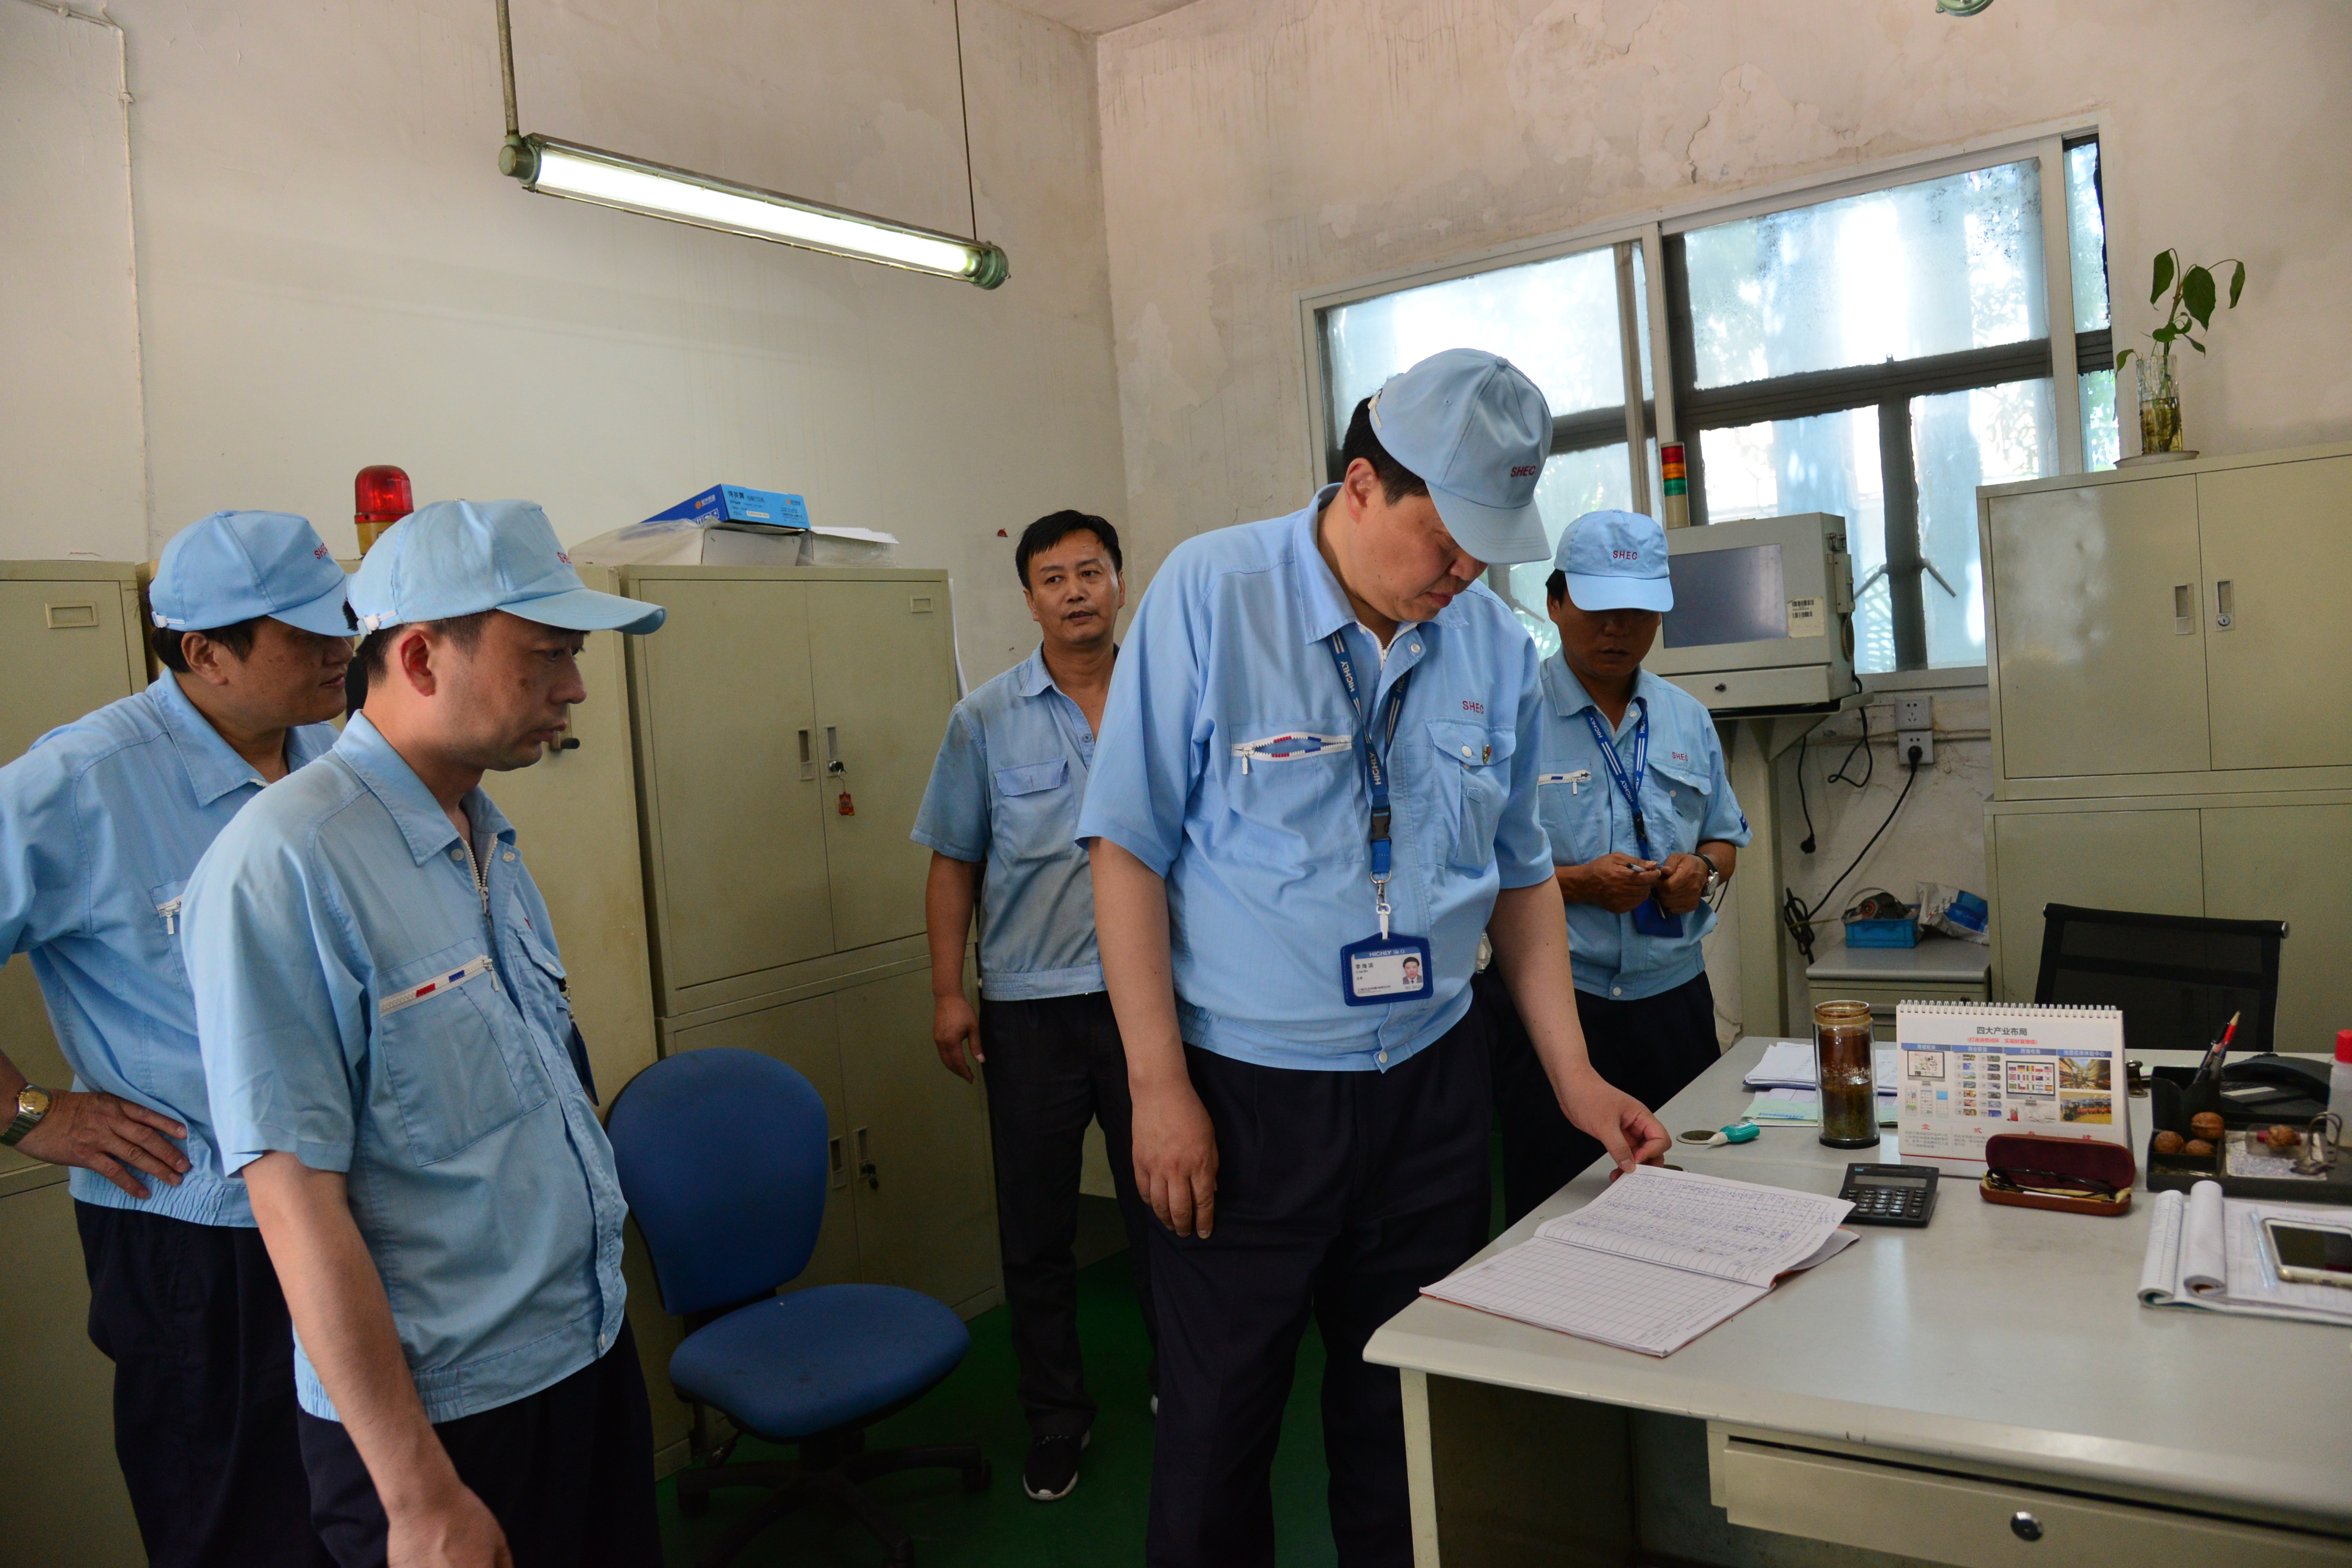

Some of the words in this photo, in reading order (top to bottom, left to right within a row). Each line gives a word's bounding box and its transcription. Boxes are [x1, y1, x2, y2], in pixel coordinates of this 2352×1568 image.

[1510, 466, 1536, 477] SHEC
[1612, 550, 1638, 560] SHEC
[1462, 701, 1484, 715] SHEC
[1977, 1026, 2027, 1036] 四大产业布局
